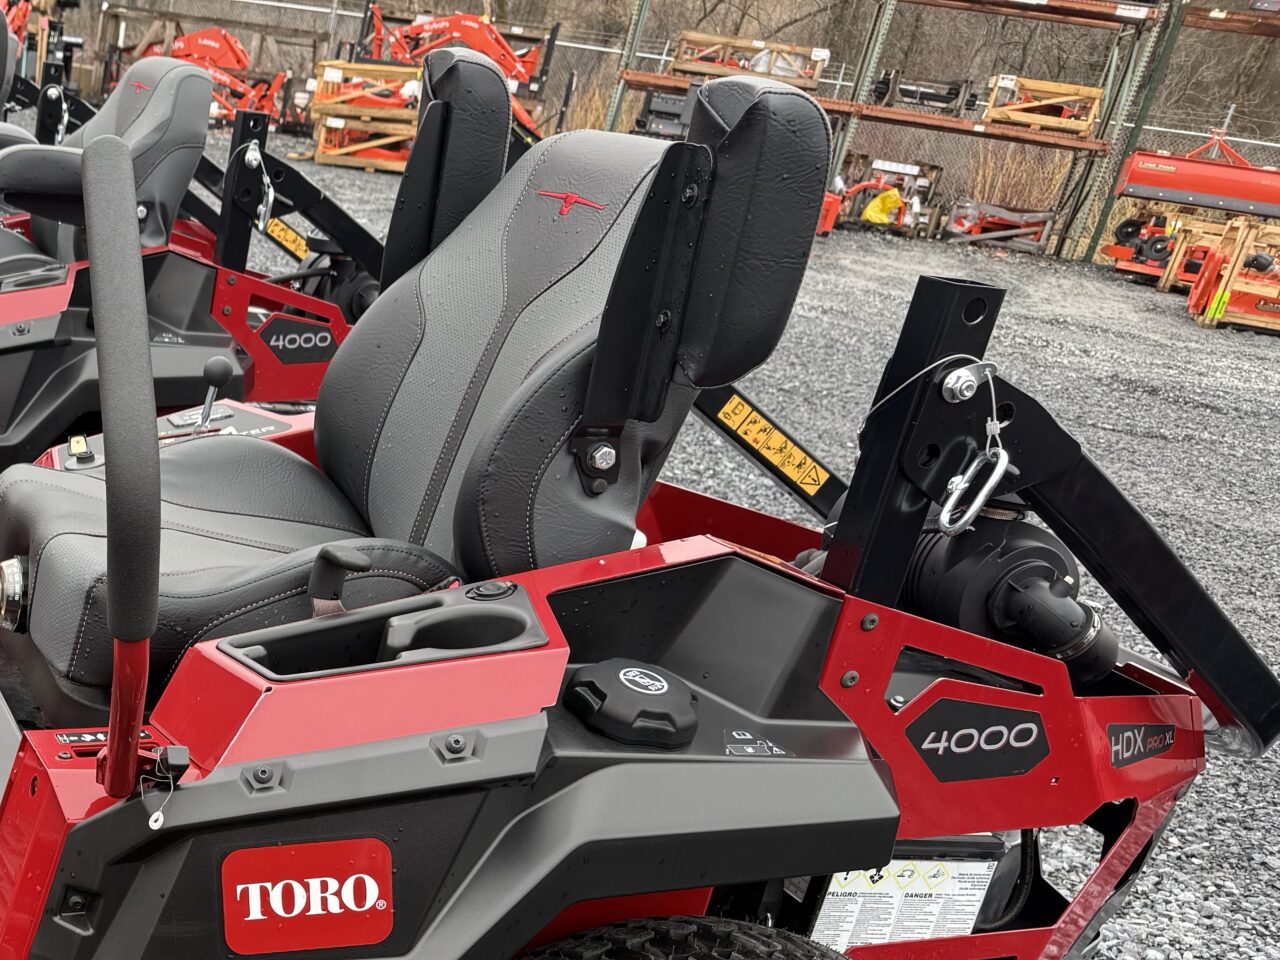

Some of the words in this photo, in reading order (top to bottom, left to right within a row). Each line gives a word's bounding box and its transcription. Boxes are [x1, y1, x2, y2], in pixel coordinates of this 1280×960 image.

[270, 332, 331, 350] 4000
[921, 722, 1039, 755] 4000
[1111, 726, 1145, 763] HDX
[1146, 735, 1165, 752] PRO
[1164, 730, 1174, 746] XL
[236, 873, 380, 921] TORO
